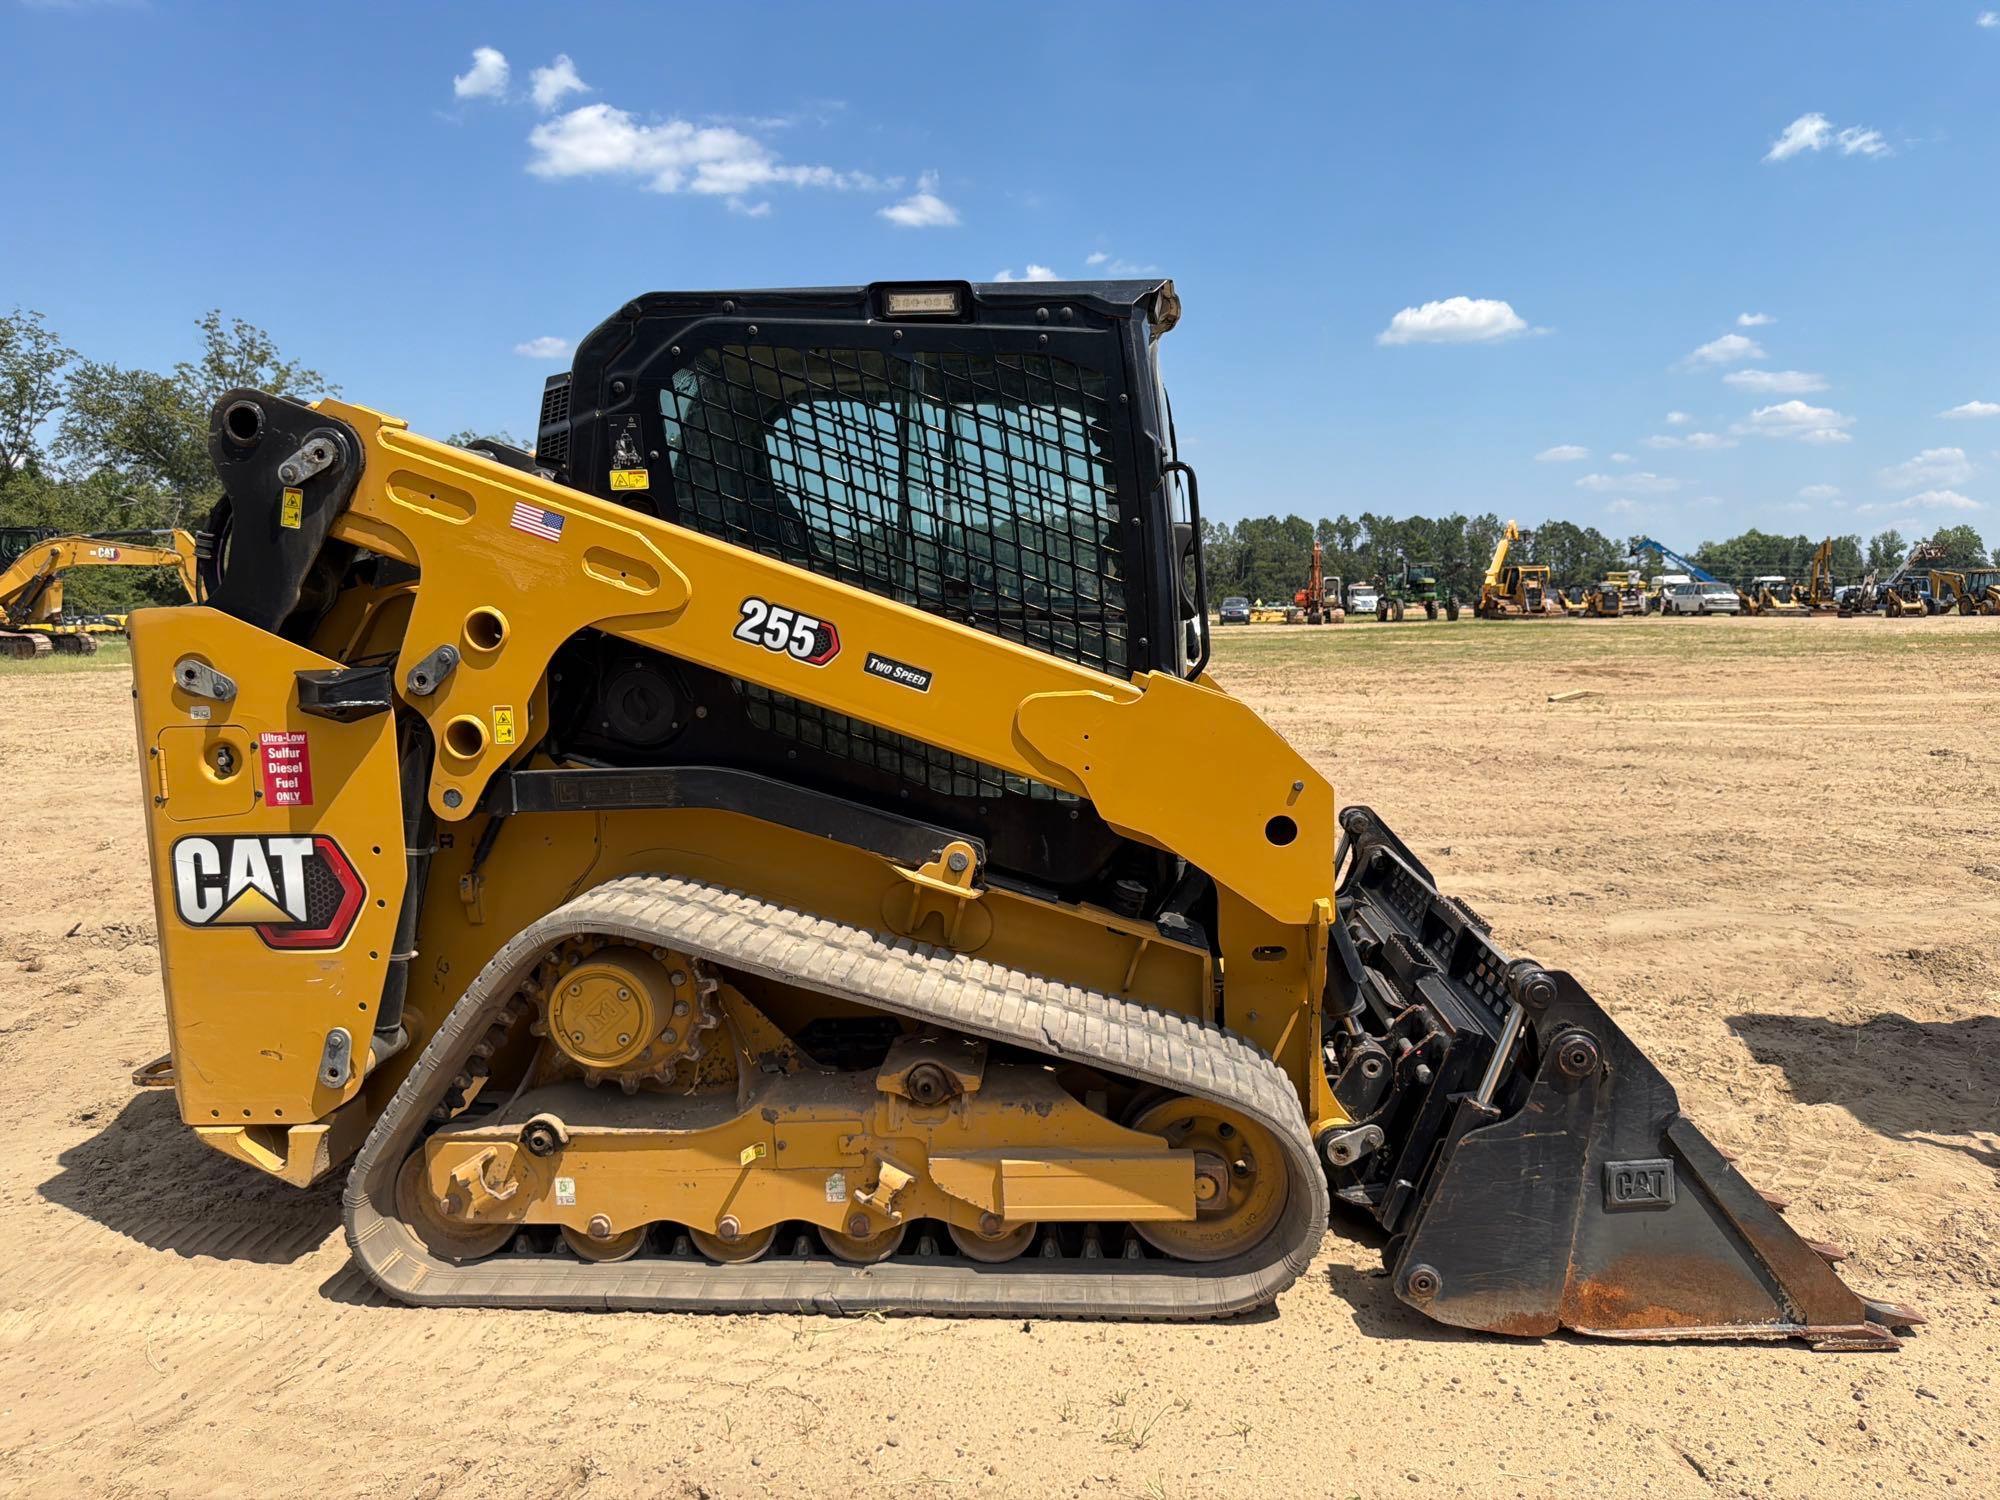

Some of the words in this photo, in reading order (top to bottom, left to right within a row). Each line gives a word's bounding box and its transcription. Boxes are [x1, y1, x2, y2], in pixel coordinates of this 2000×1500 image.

[98, 547, 116, 559] CAT
[736, 599, 819, 658] 255
[261, 732, 305, 743] Ultra-Low
[268, 747, 300, 759] Sulfur
[268, 761, 303, 774] Diesel
[275, 776, 299, 788] Fuel
[276, 791, 301, 801] ONLY
[175, 837, 314, 923] CAT
[1615, 1169, 1665, 1201] CAT
